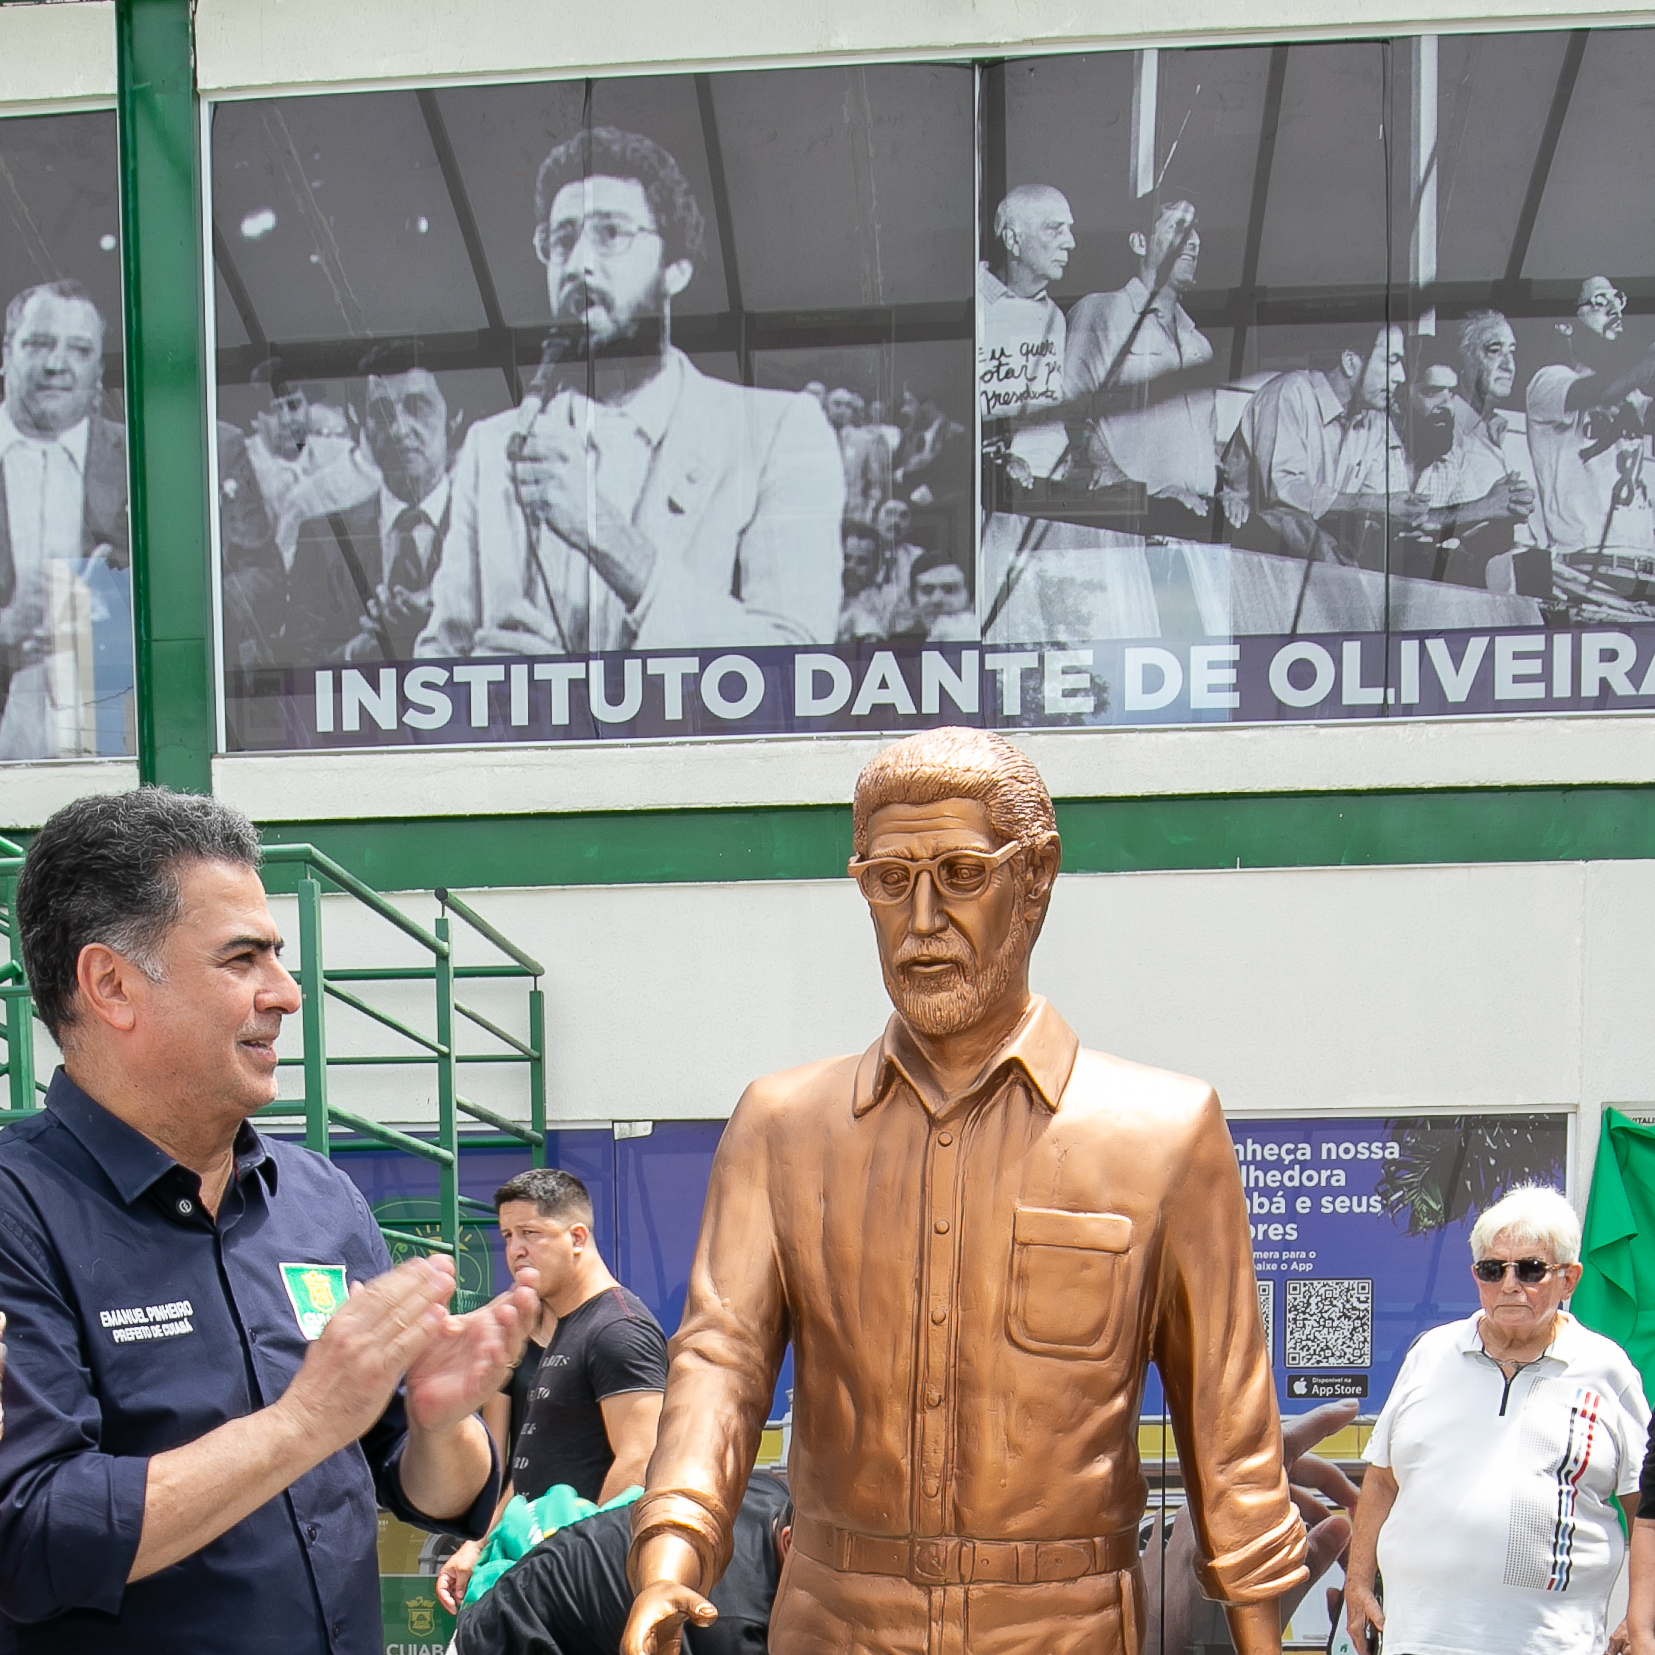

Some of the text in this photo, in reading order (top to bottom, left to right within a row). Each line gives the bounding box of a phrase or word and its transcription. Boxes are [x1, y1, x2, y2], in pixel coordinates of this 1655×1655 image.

[979, 360, 1037, 384] otar
[315, 652, 765, 734] INSTITUTO
[792, 645, 1095, 717] DANTE
[1124, 641, 1242, 711] DE
[1233, 1138, 1401, 1165] nheça nossa
[1240, 1164, 1347, 1187] lhedora
[1295, 1198, 1312, 1214] e
[1320, 1194, 1382, 1214] seus
[1253, 1251, 1317, 1262] mera para o
[1280, 1262, 1288, 1271] o
[1290, 1261, 1314, 1272] App
[100, 1300, 194, 1327] EMANUEL PINHEIRO
[112, 1317, 194, 1343] PREFEITO DE CUIABÁ
[1311, 1384, 1363, 1396] App Store
